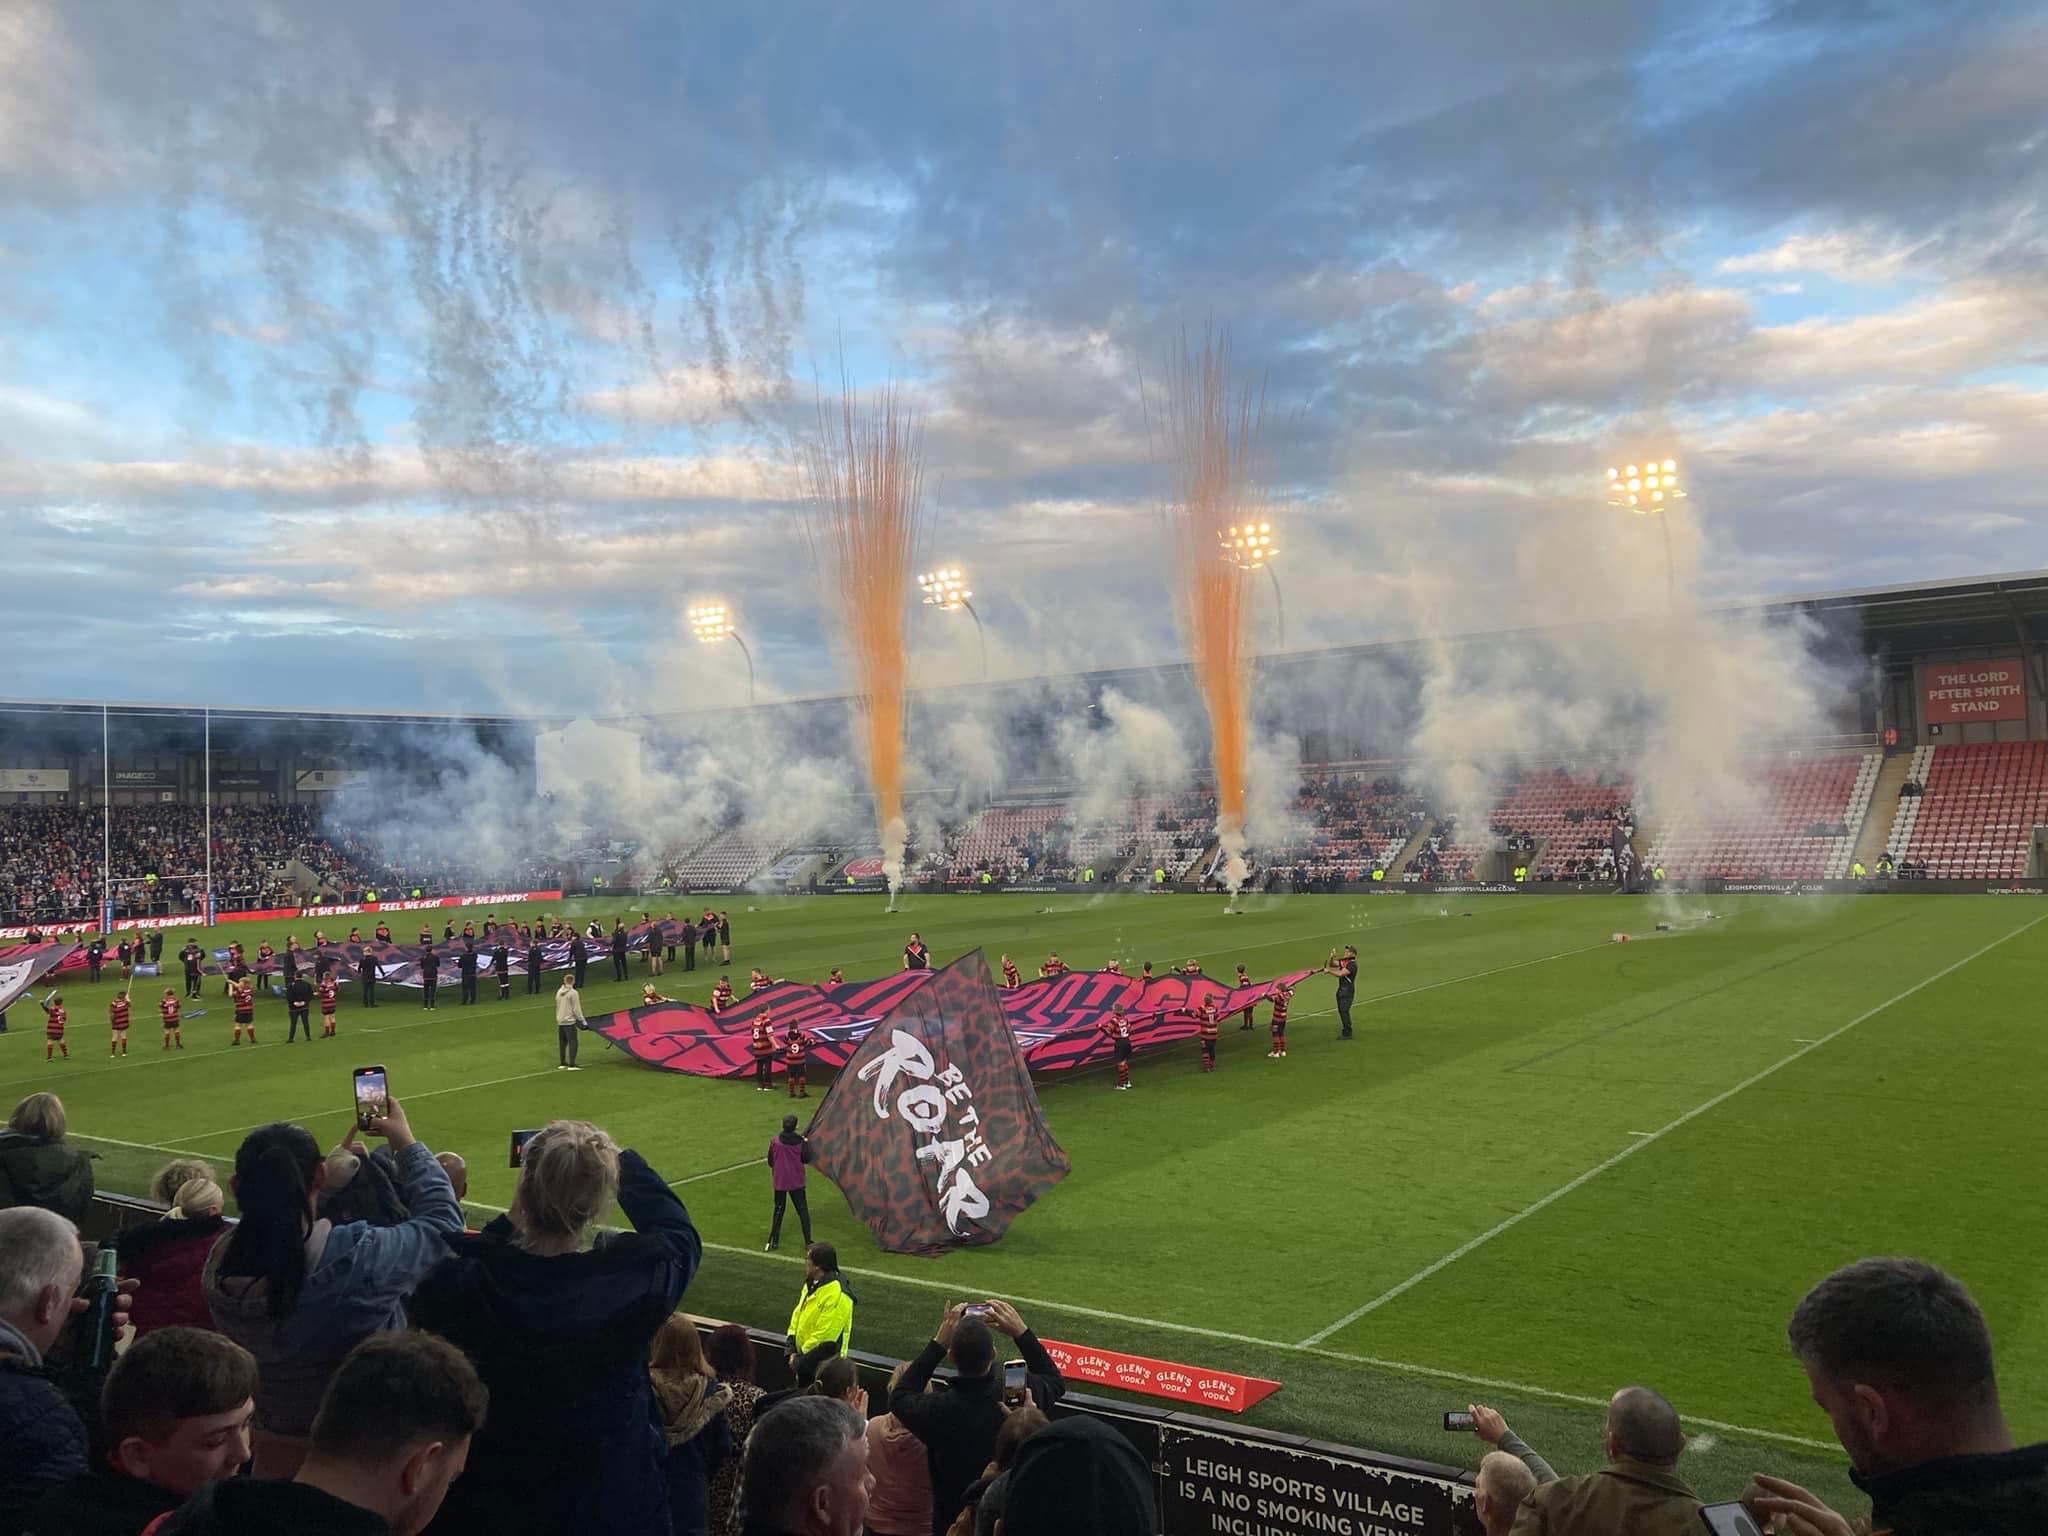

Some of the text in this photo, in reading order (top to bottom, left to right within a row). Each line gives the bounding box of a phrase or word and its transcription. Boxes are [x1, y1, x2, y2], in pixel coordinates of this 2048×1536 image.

[1937, 671, 2009, 685] THE LORD
[1928, 685, 2021, 700] PETER SMITH
[1951, 701, 2000, 713] STAND
[379, 902, 402, 912] FEEL
[403, 901, 419, 910] THE
[117, 922, 134, 931] UP
[137, 919, 157, 929] THE
[753, 1028, 760, 1039] 8
[791, 1043, 800, 1054] 9
[933, 1062, 993, 1168] BE THE
[857, 1029, 990, 1238] ROAR
[1077, 1356, 1111, 1371] GLEN'S
[1081, 1367, 1105, 1377] VODKA
[1116, 1363, 1151, 1379] GLEN'S
[1120, 1375, 1146, 1385] VODKA
[1156, 1371, 1193, 1387] GLEN'S
[1161, 1383, 1187, 1394] VODKA
[1198, 1379, 1236, 1396] GLEN'S
[1203, 1390, 1230, 1403] VODKA
[1186, 1457, 1424, 1526] LEIGH SPORTS VILLAGE
[1179, 1480, 1196, 1499] IS
[1202, 1487, 1215, 1505] A
[1222, 1490, 1250, 1511] NO
[1257, 1499, 1352, 1535] SMOKING
